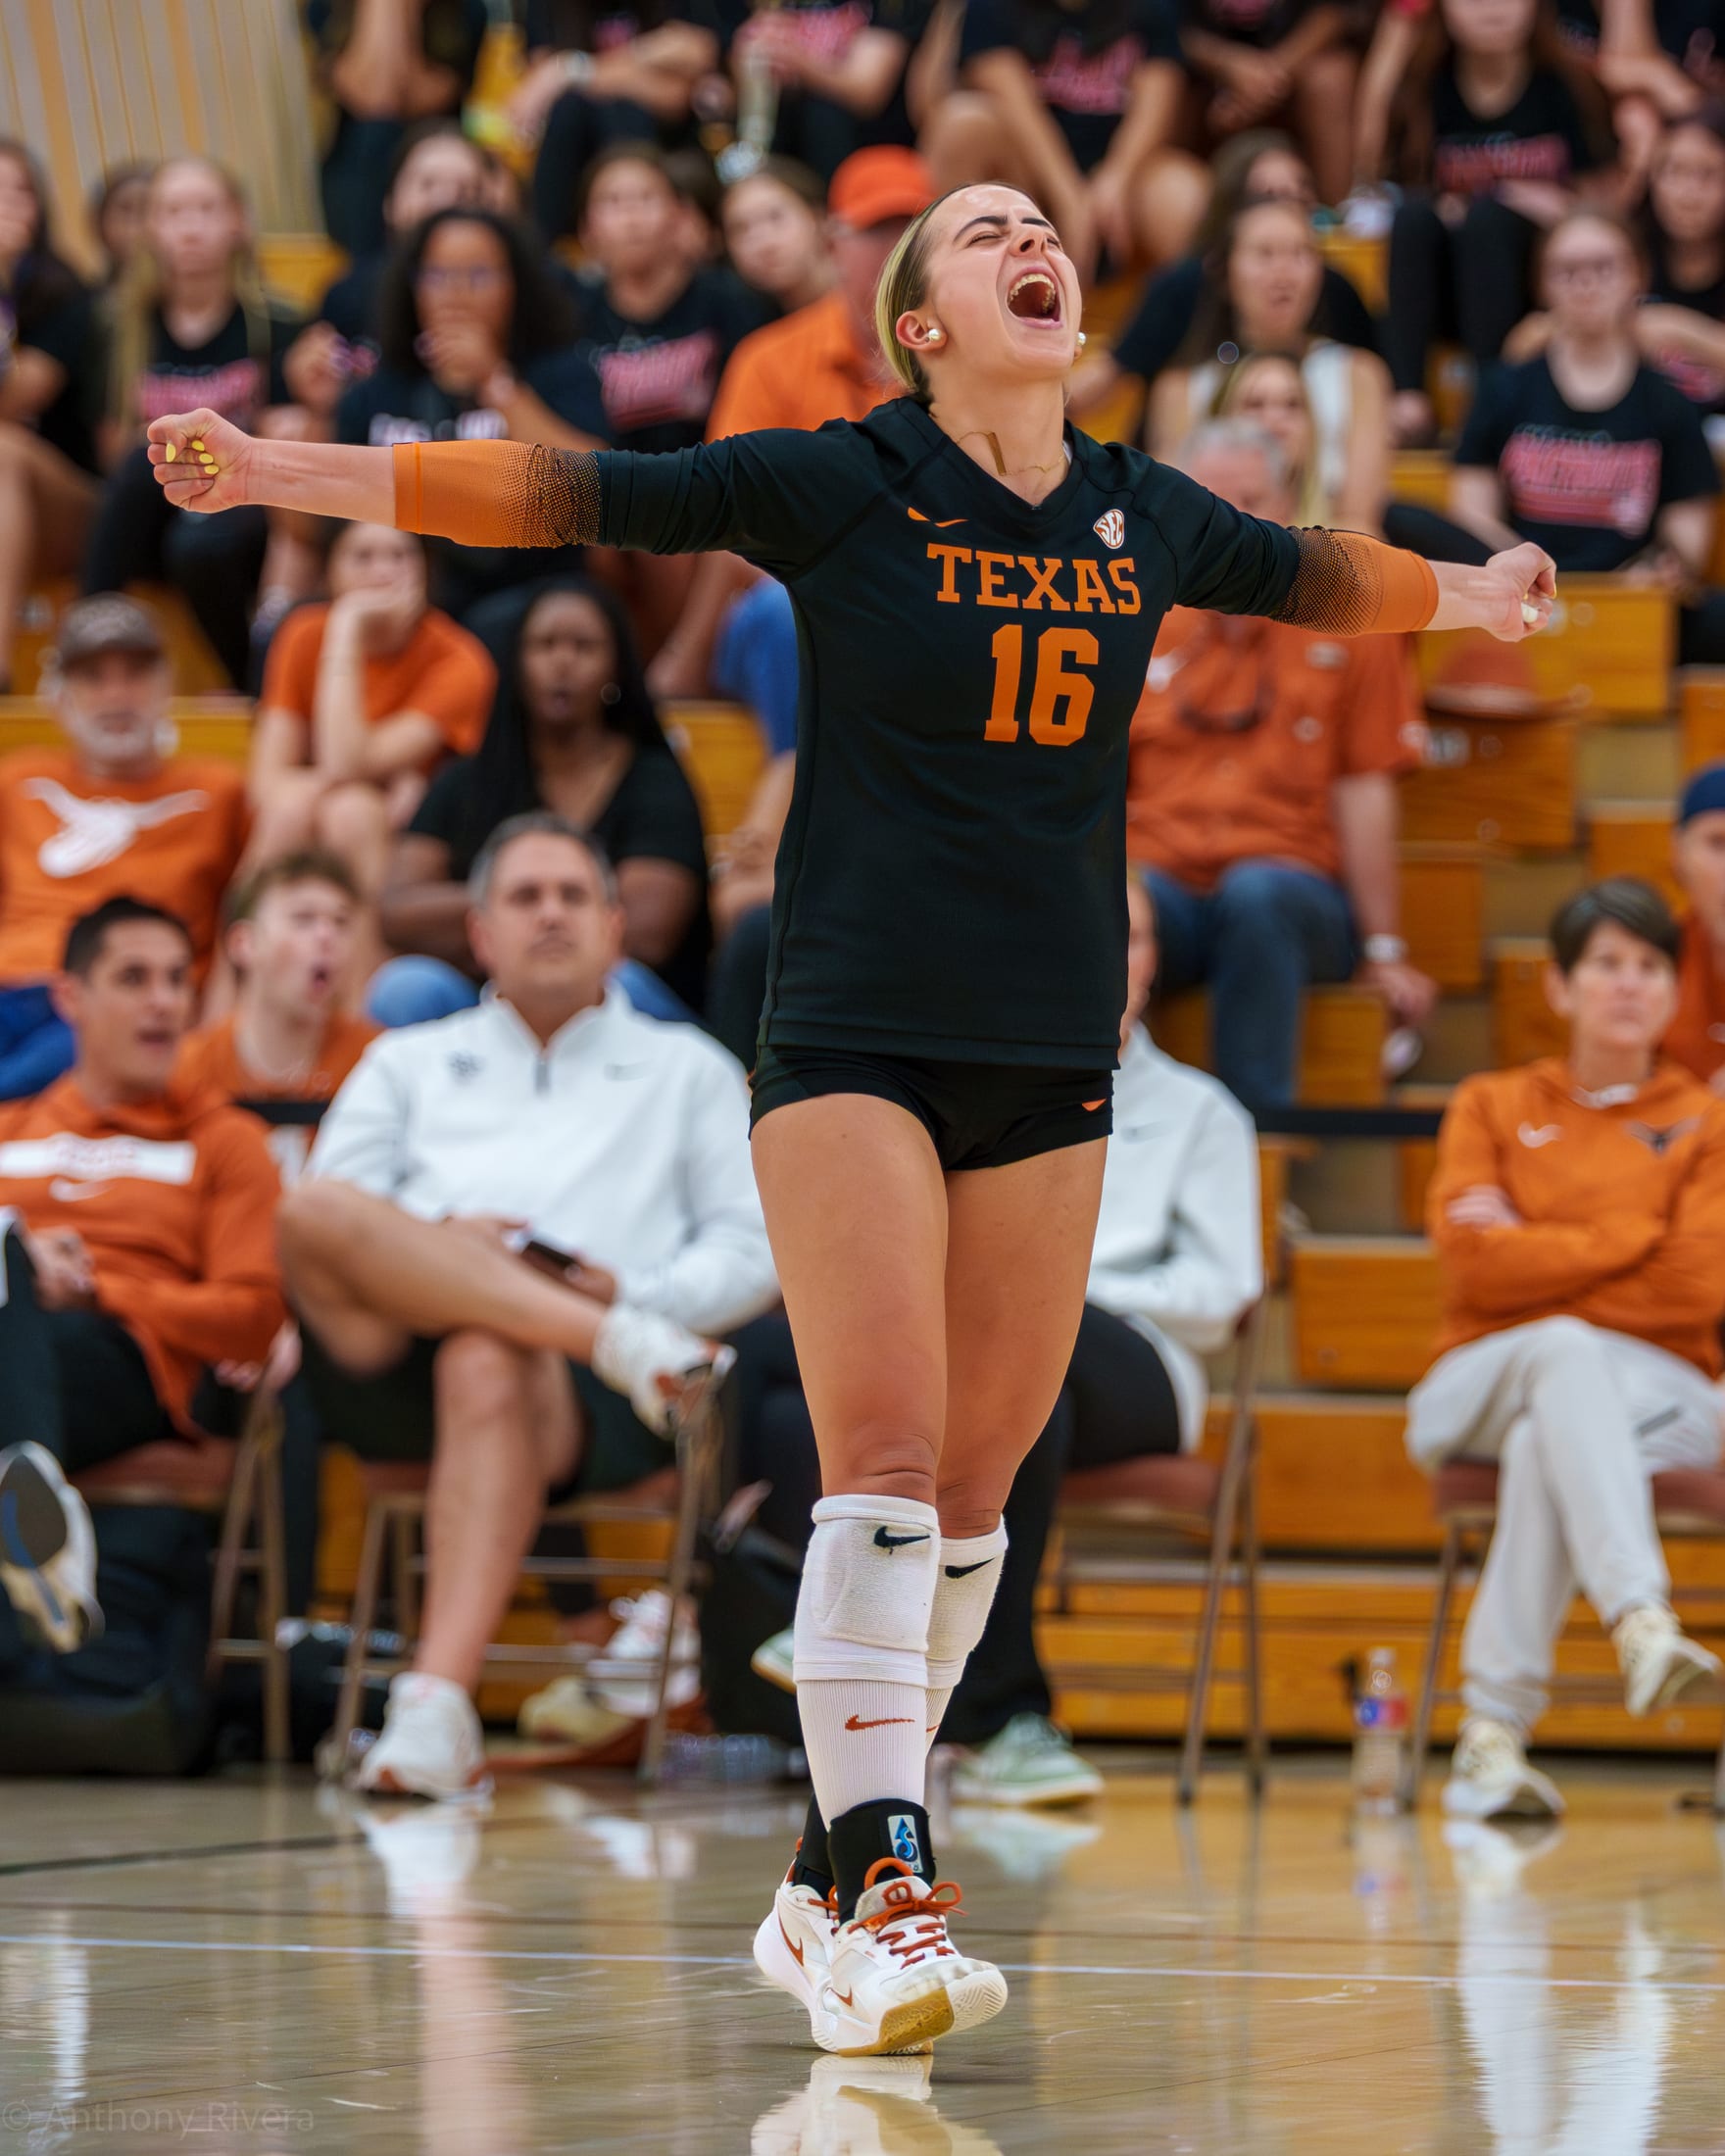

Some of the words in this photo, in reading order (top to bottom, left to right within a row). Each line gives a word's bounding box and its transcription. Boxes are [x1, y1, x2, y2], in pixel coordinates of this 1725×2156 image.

[1094, 510, 1124, 548] SEC
[927, 543, 1141, 614] TEXAS
[984, 623, 1099, 747] 16
